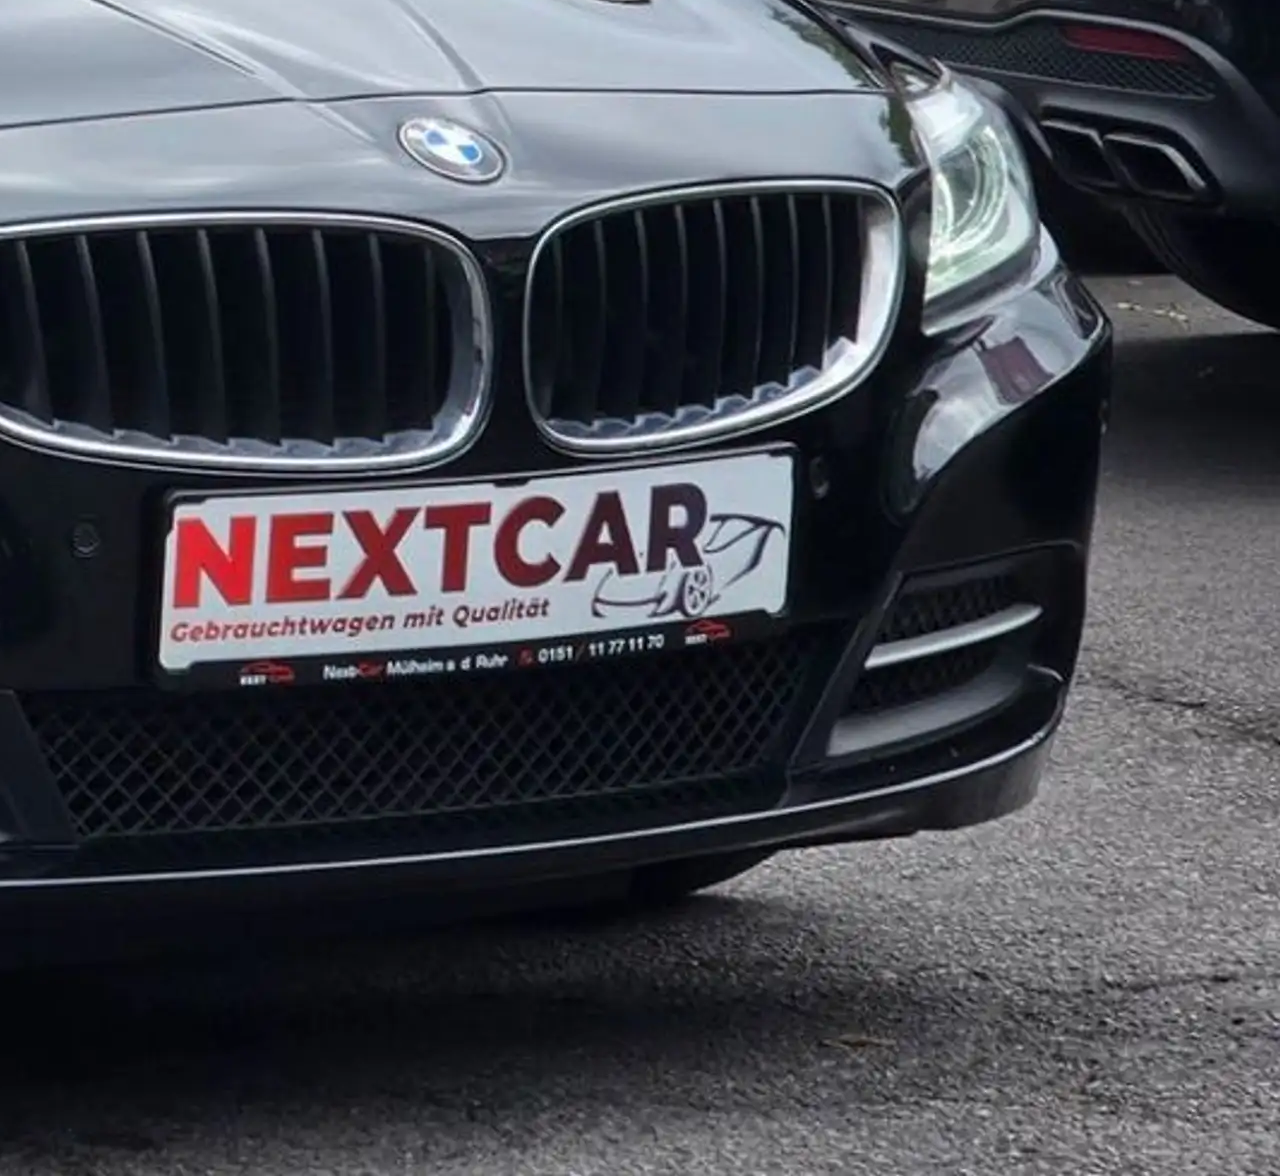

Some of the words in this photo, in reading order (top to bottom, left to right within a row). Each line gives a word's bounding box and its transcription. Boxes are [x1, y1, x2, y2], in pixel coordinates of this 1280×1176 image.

[173, 482, 707, 609] NEXTCAR
[171, 612, 395, 643] Gebrauchtwagen
[403, 604, 445, 629] mit
[452, 597, 551, 625] Qualität
[538, 645, 574, 663] 0151
